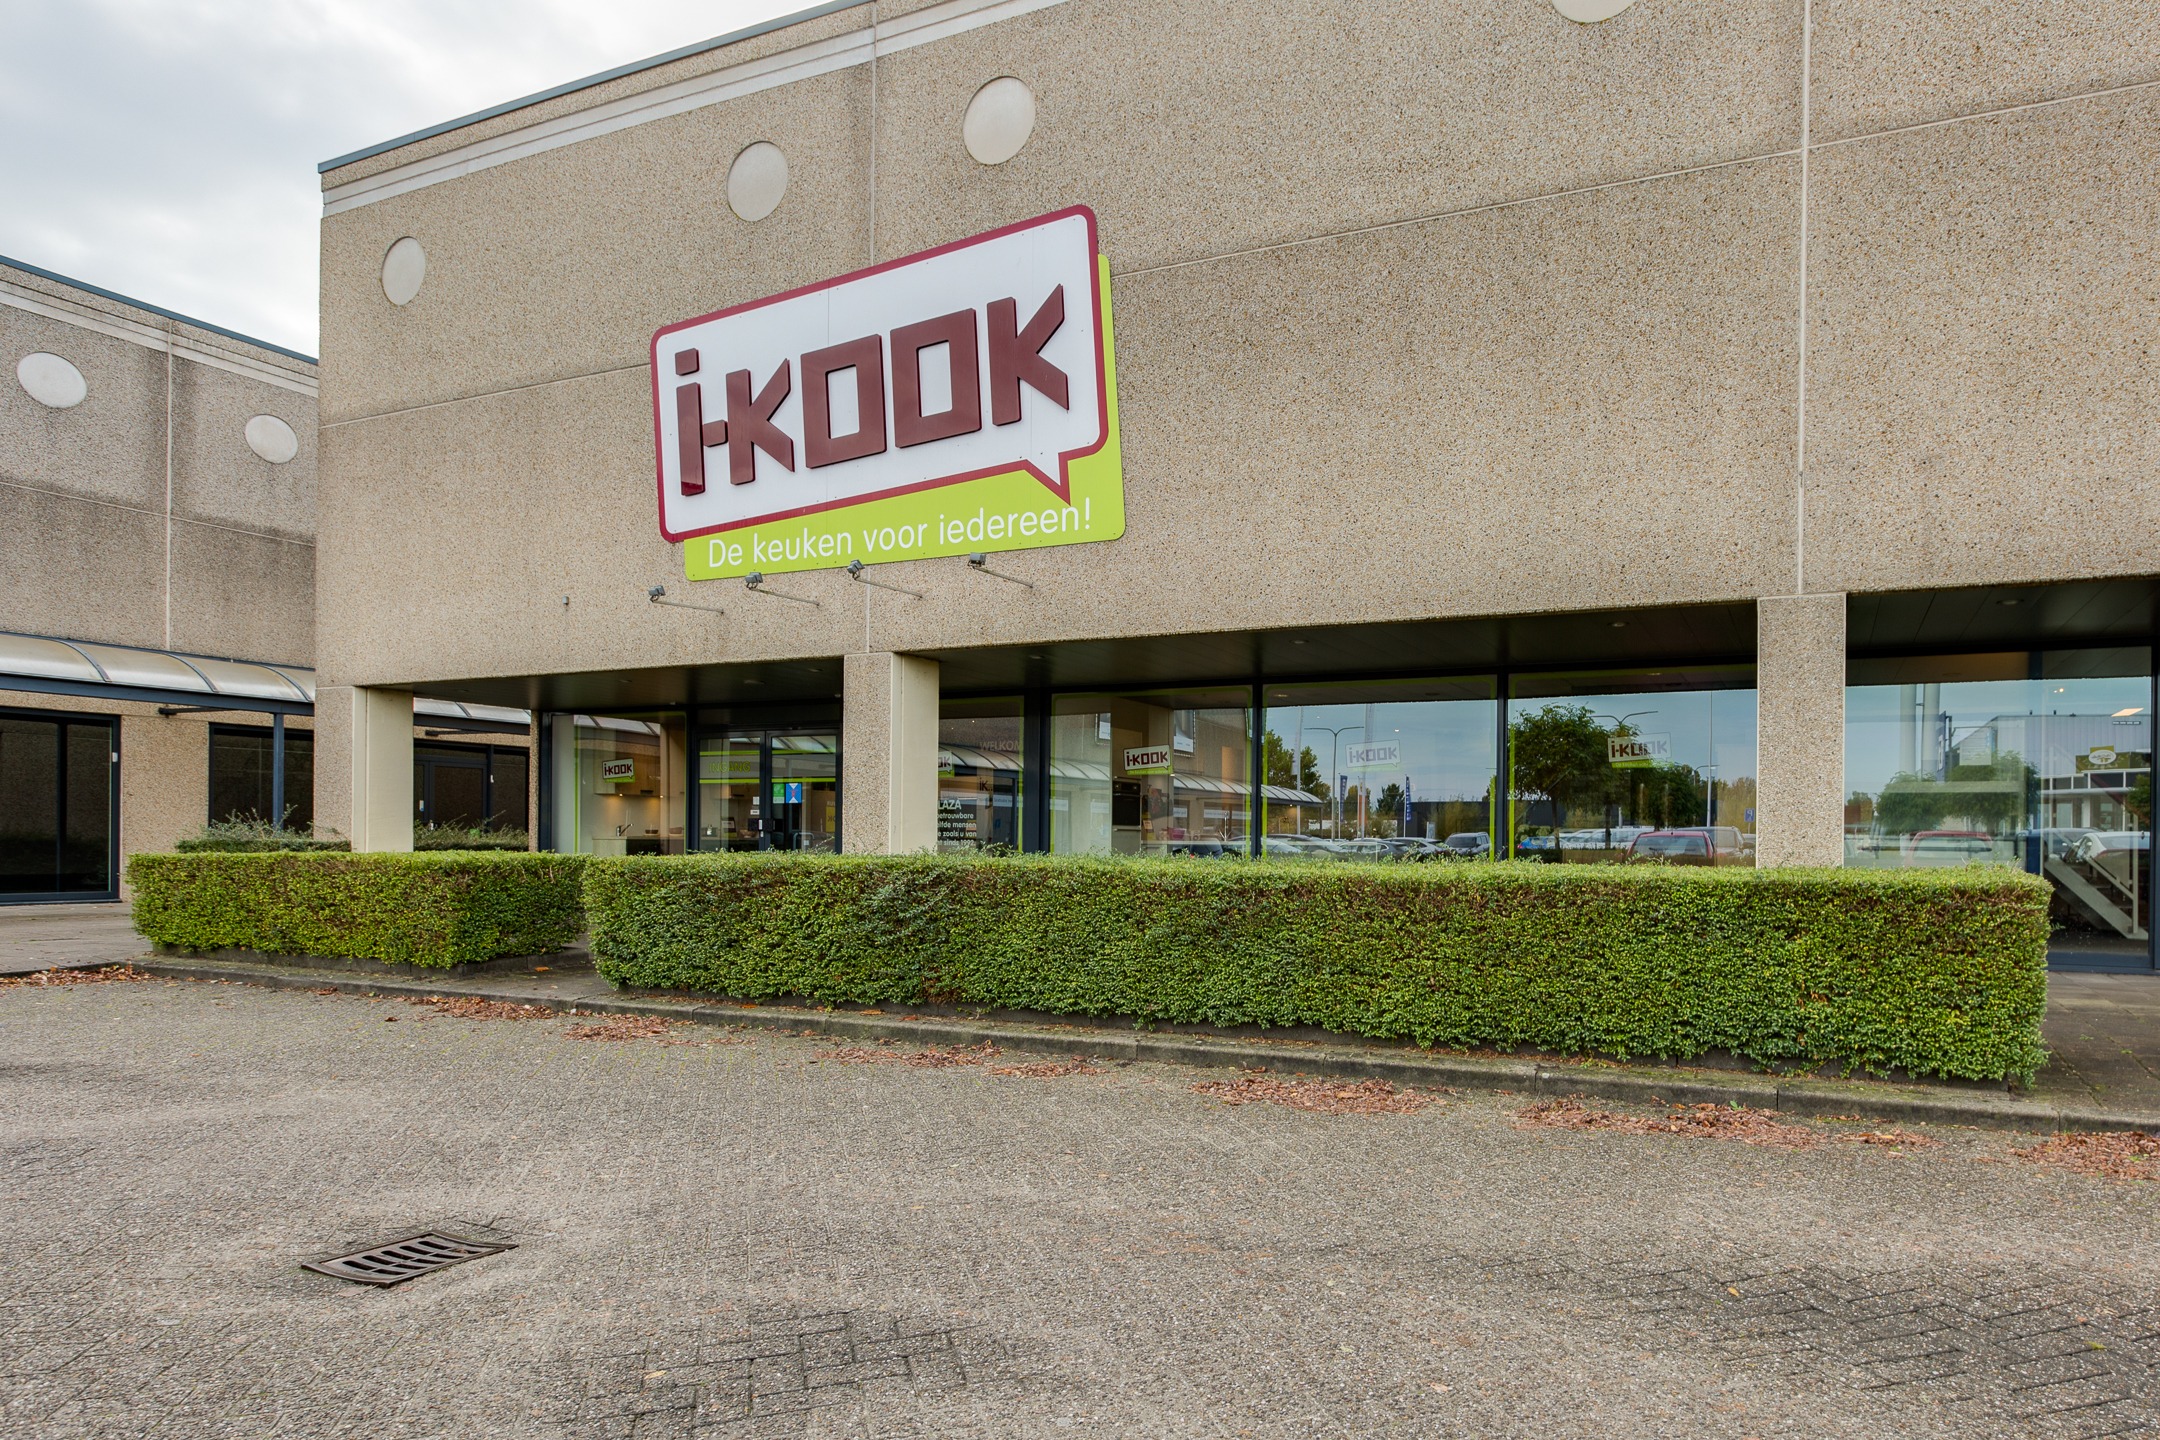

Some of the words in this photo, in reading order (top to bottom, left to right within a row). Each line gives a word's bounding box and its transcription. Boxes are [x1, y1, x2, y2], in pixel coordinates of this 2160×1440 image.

[675, 283, 1070, 496] i-KOOK
[709, 539, 743, 568] De
[753, 527, 852, 564] keuken
[863, 522, 928, 553] voor
[939, 496, 1090, 545] iedereen!
[709, 760, 751, 773] INGANG
[1126, 751, 1168, 767] i-KOOK
[938, 799, 962, 810] LAZA
